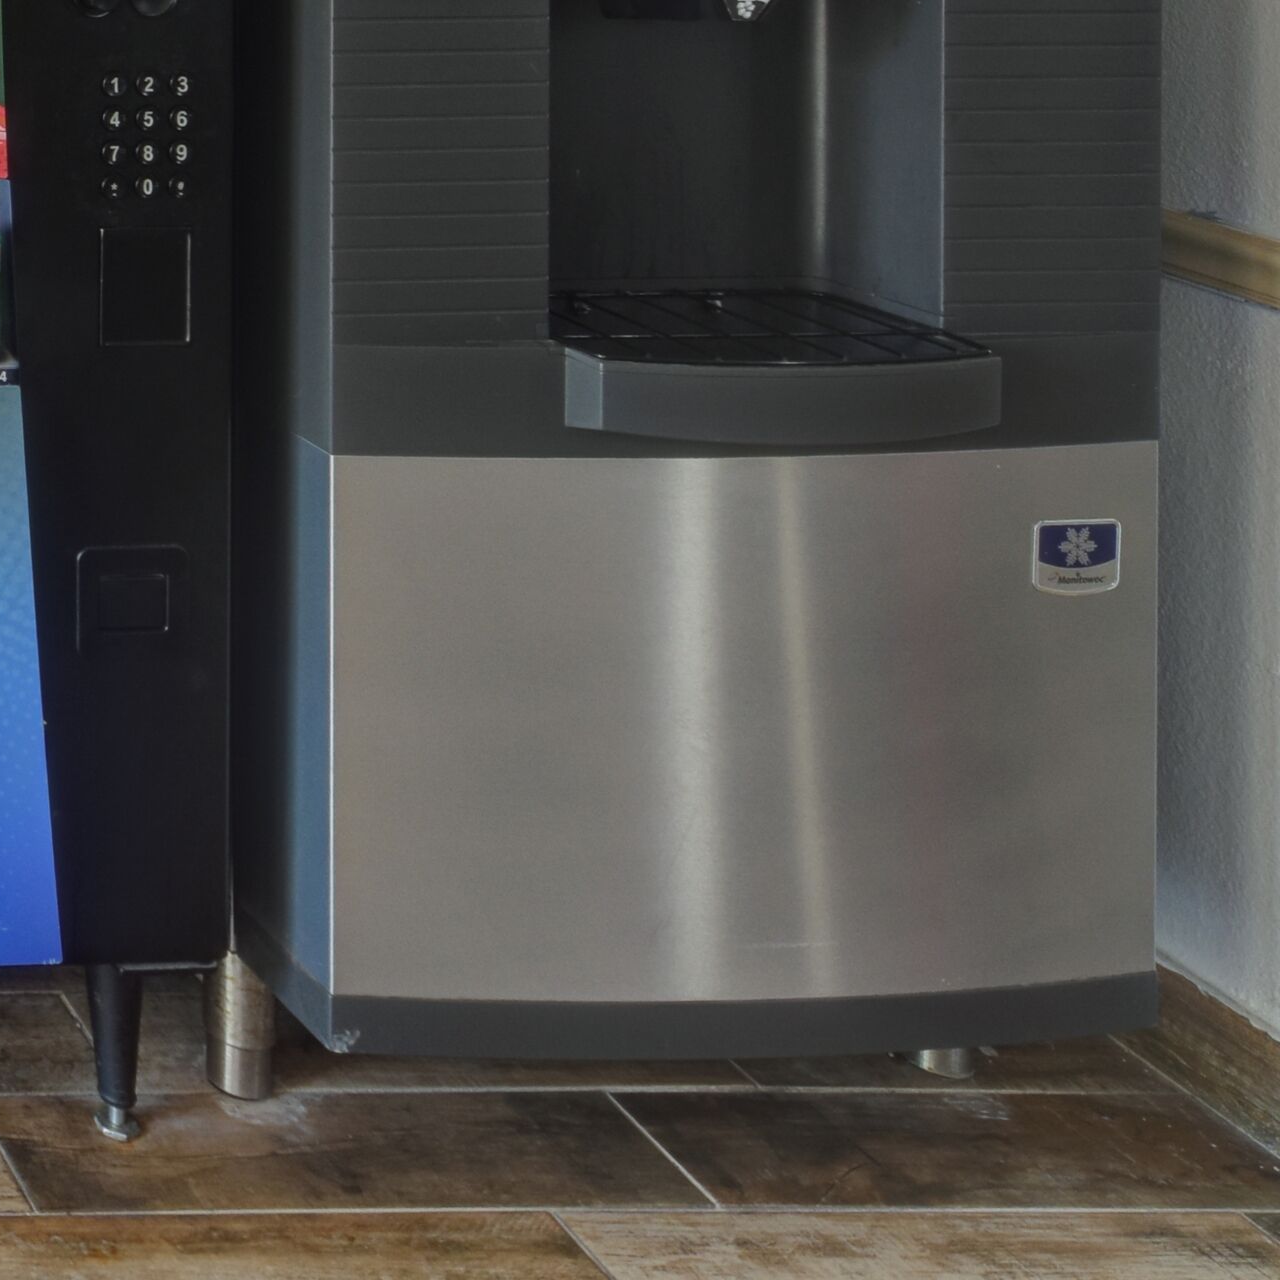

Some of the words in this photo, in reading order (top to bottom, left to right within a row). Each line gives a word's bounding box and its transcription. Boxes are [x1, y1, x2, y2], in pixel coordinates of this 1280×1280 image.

[110, 77, 119, 93] 1
[144, 77, 154, 92] 2
[177, 76, 188, 93] 3
[109, 111, 120, 127] 4
[143, 111, 154, 127] 5
[177, 111, 188, 127] 6
[110, 145, 120, 162] 7
[143, 145, 154, 161] 8
[176, 144, 187, 161] 9
[143, 179, 153, 195] 0
